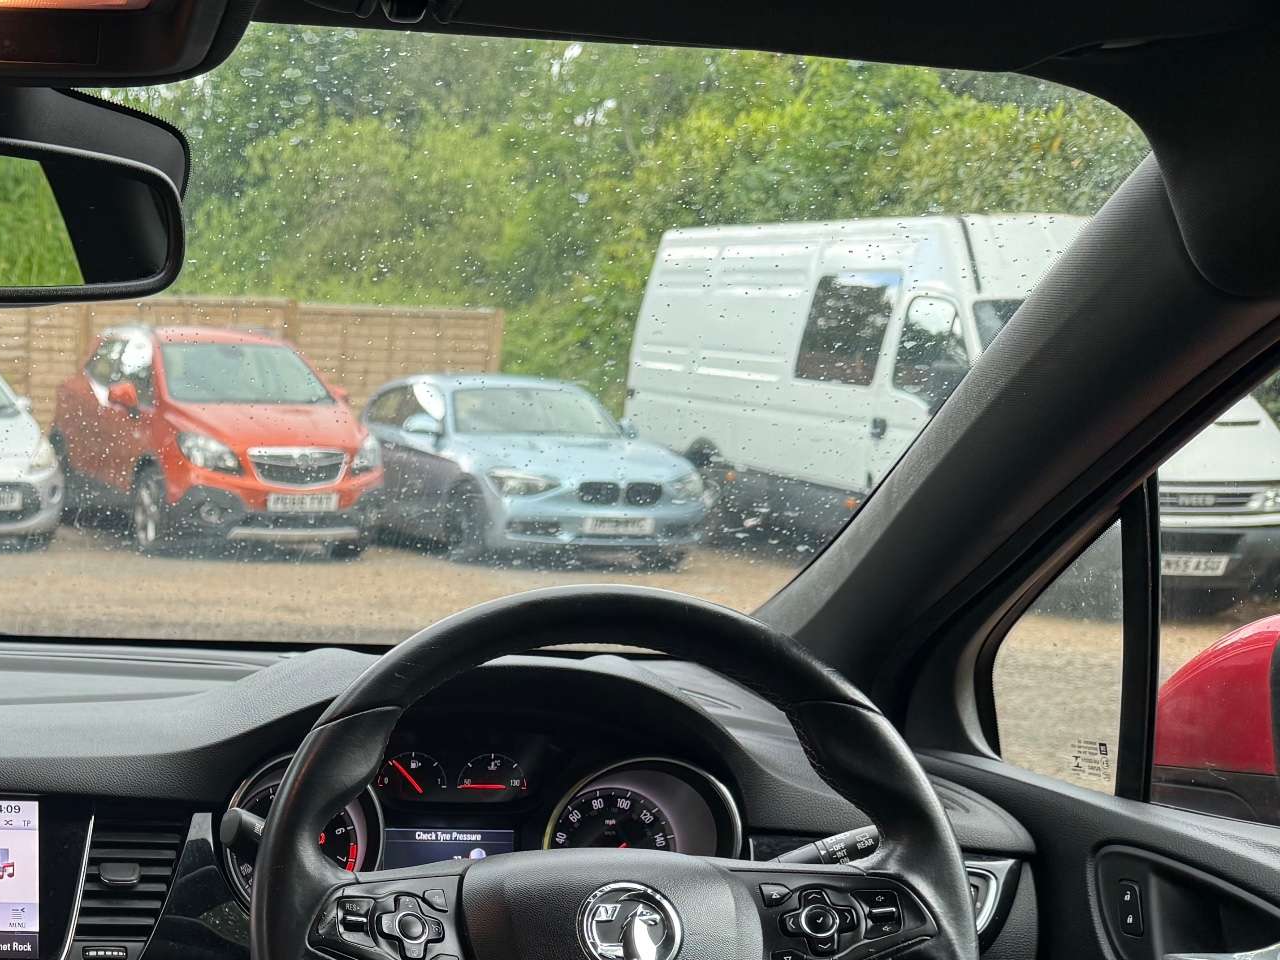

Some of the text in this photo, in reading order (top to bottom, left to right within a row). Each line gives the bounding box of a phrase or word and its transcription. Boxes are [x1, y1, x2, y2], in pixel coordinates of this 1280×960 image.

[510, 779, 521, 787] 130
[591, 799, 604, 810] 80
[616, 798, 631, 810] 100
[568, 809, 582, 823] 60
[640, 810, 654, 824] 120
[23, 819, 31, 827] TP
[415, 831, 481, 843] Check Tyre Pressure
[555, 832, 567, 844] 40
[654, 832, 666, 848] 140
[856, 838, 875, 850] REAR
[13, 942, 32, 952] Rock
